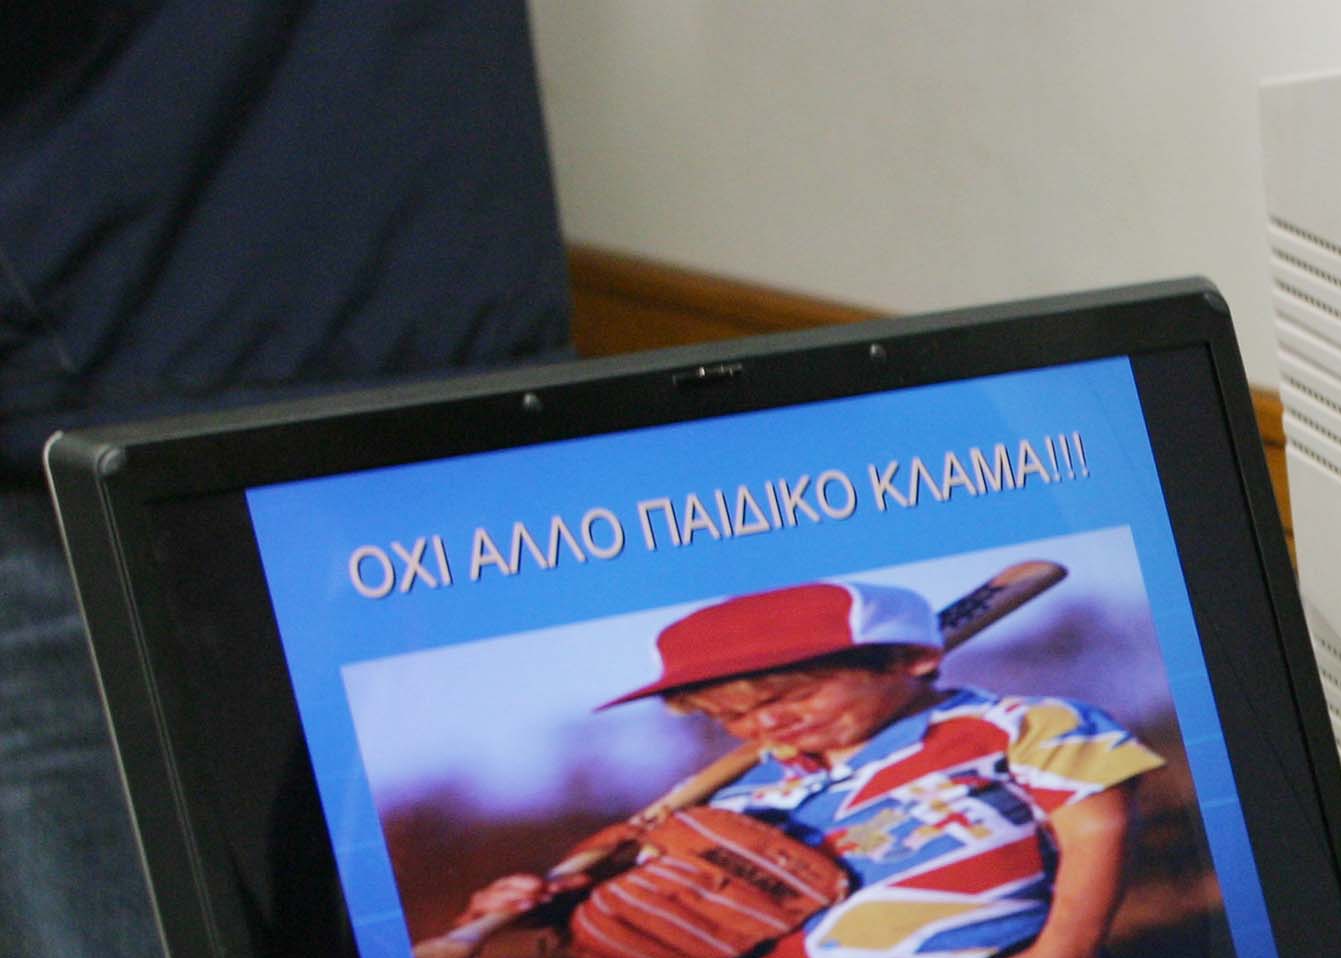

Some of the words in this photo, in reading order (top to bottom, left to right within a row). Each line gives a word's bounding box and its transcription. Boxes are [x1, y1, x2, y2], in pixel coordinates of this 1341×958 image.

[349, 535, 454, 600] ΟΧΙ
[469, 507, 627, 583] ΑΛΛΟ
[638, 468, 859, 551] ΠΑΙΔΙΚΟ
[869, 430, 1093, 512] ΚΛΑΜΑ!!!
